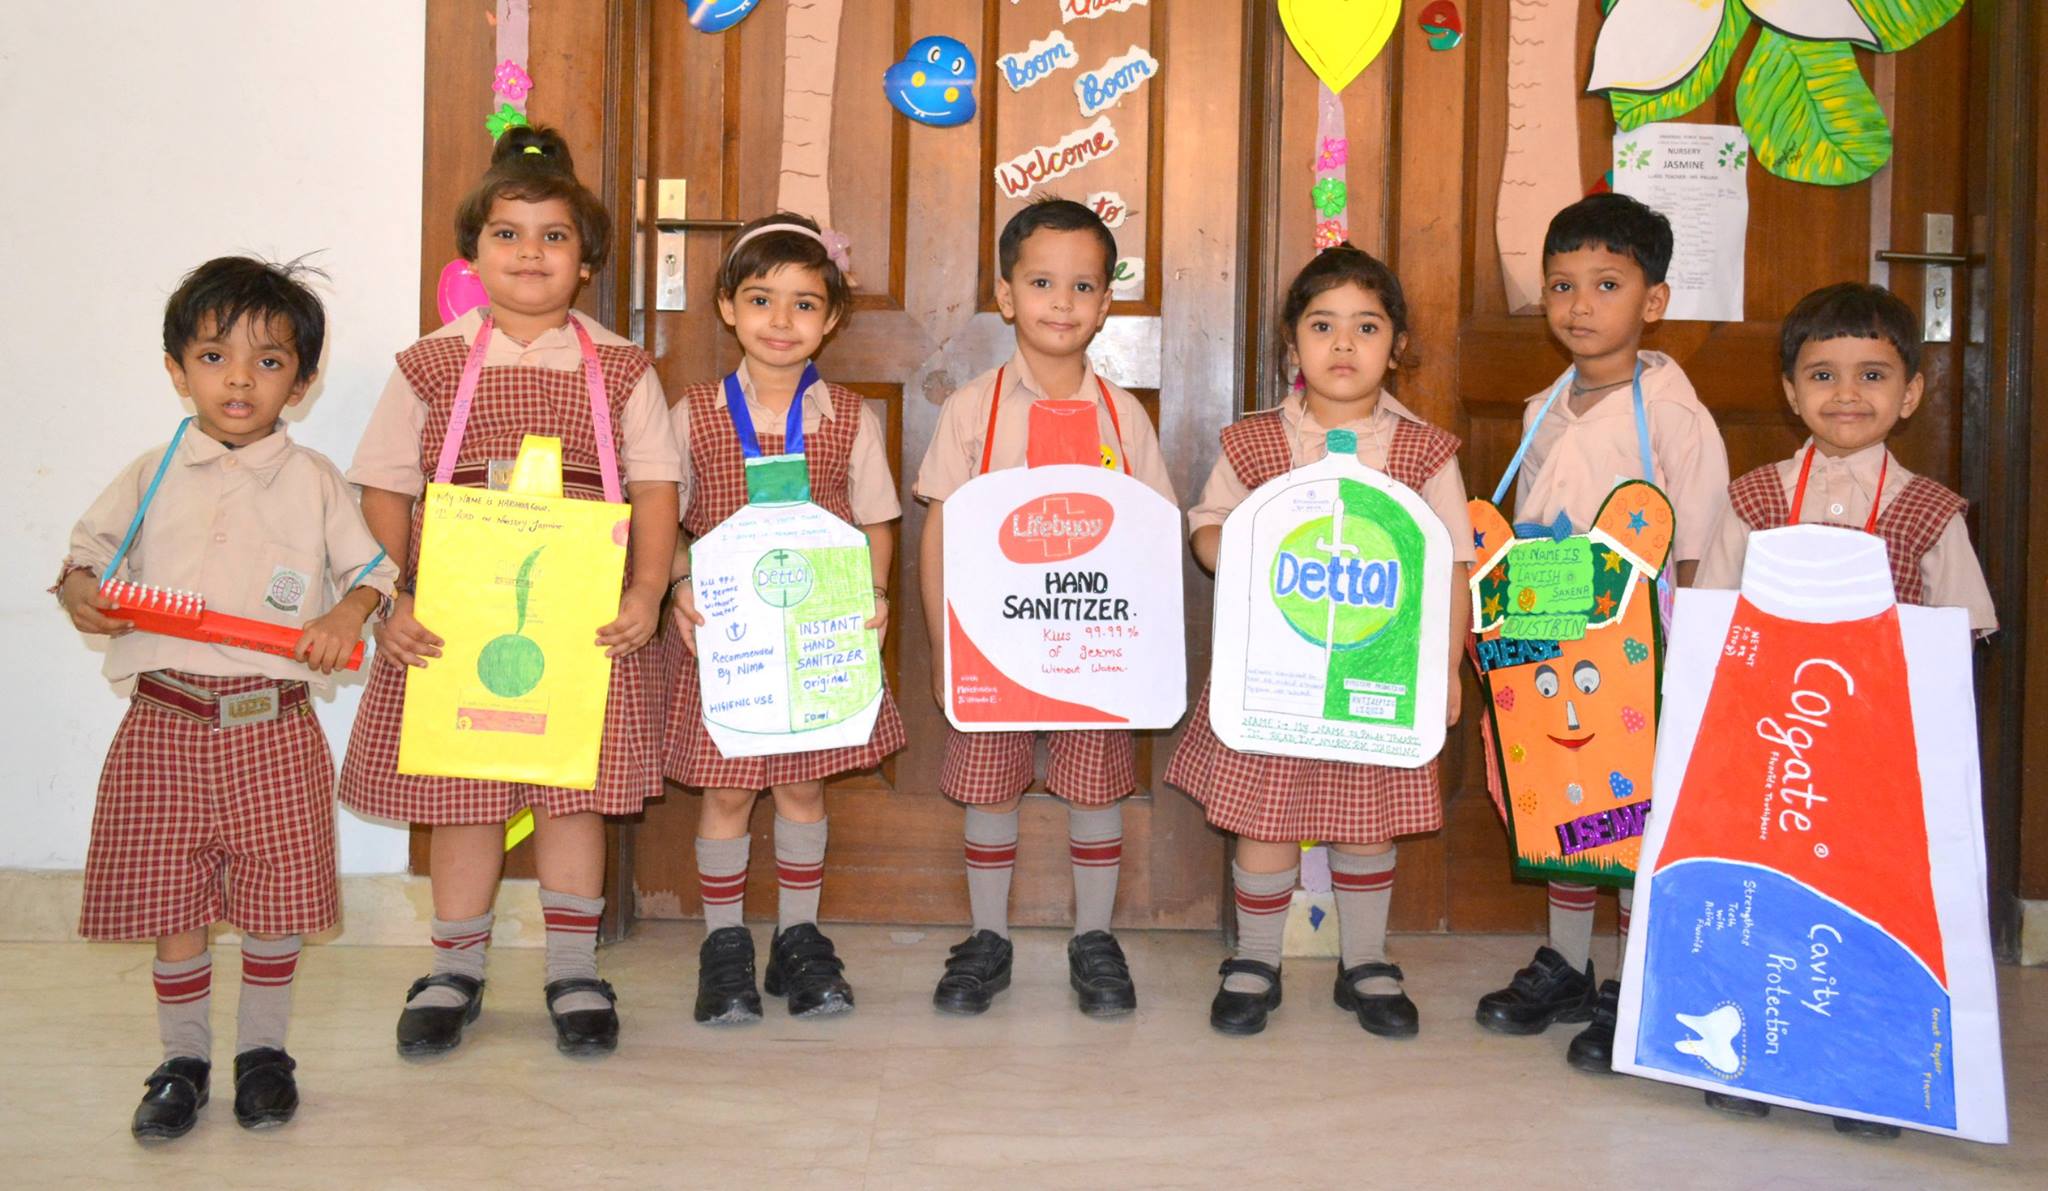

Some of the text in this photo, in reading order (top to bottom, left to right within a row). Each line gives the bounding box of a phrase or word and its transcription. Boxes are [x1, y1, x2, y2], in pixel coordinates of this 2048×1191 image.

[1003, 42, 1070, 89] Boom
[1078, 58, 1150, 110] Boom
[1667, 147, 1701, 155] NURSERY
[1000, 131, 1114, 195] Welcome
[1663, 160, 1705, 169] JASMINE
[1012, 512, 1104, 538] Lifebuoy
[1529, 547, 1560, 561] NAME
[1561, 547, 1580, 562] IS
[1045, 571, 1108, 594] HAND
[1275, 551, 1399, 609] Dettol
[1516, 568, 1561, 584] LAVISH
[799, 615, 861, 635] INSTANT
[1504, 617, 1588, 638] DUSTBIN
[802, 639, 836, 653] HAND
[1079, 644, 1123, 661] germs
[1476, 637, 1565, 673] PLEASE
[795, 648, 865, 671] SANITIZER
[753, 694, 774, 705] USE
[1756, 658, 1855, 832] Colgate
[1715, 909, 1725, 931] with
[1727, 902, 1740, 928] Teeth
[1740, 879, 1757, 947] Strengthens
[1800, 923, 1843, 1017] Cavity
[1764, 953, 1798, 1055] Protection
